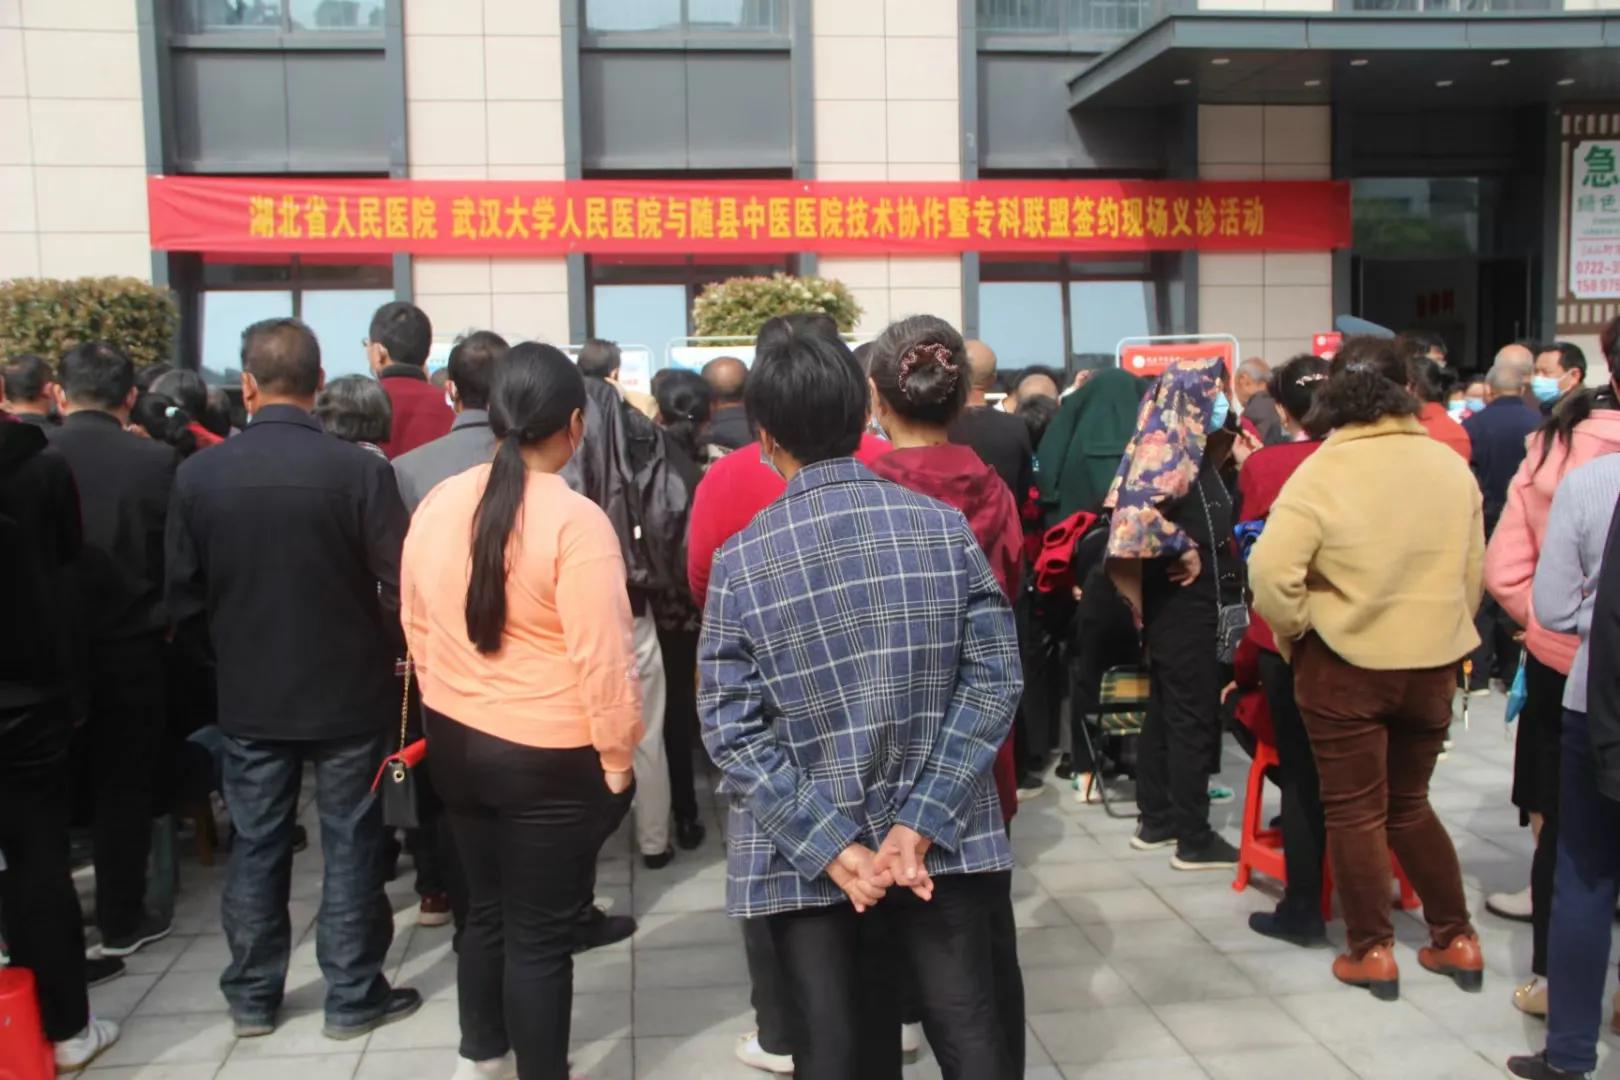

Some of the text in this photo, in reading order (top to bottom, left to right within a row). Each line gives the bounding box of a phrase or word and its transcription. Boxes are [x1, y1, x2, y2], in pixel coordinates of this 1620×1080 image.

[1582, 144, 1620, 188] 急
[249, 194, 1265, 240] 湖北省人民医院 武汉大学人民医院与随县中医医院技术协作暨专科联盟签约现场义诊活动
